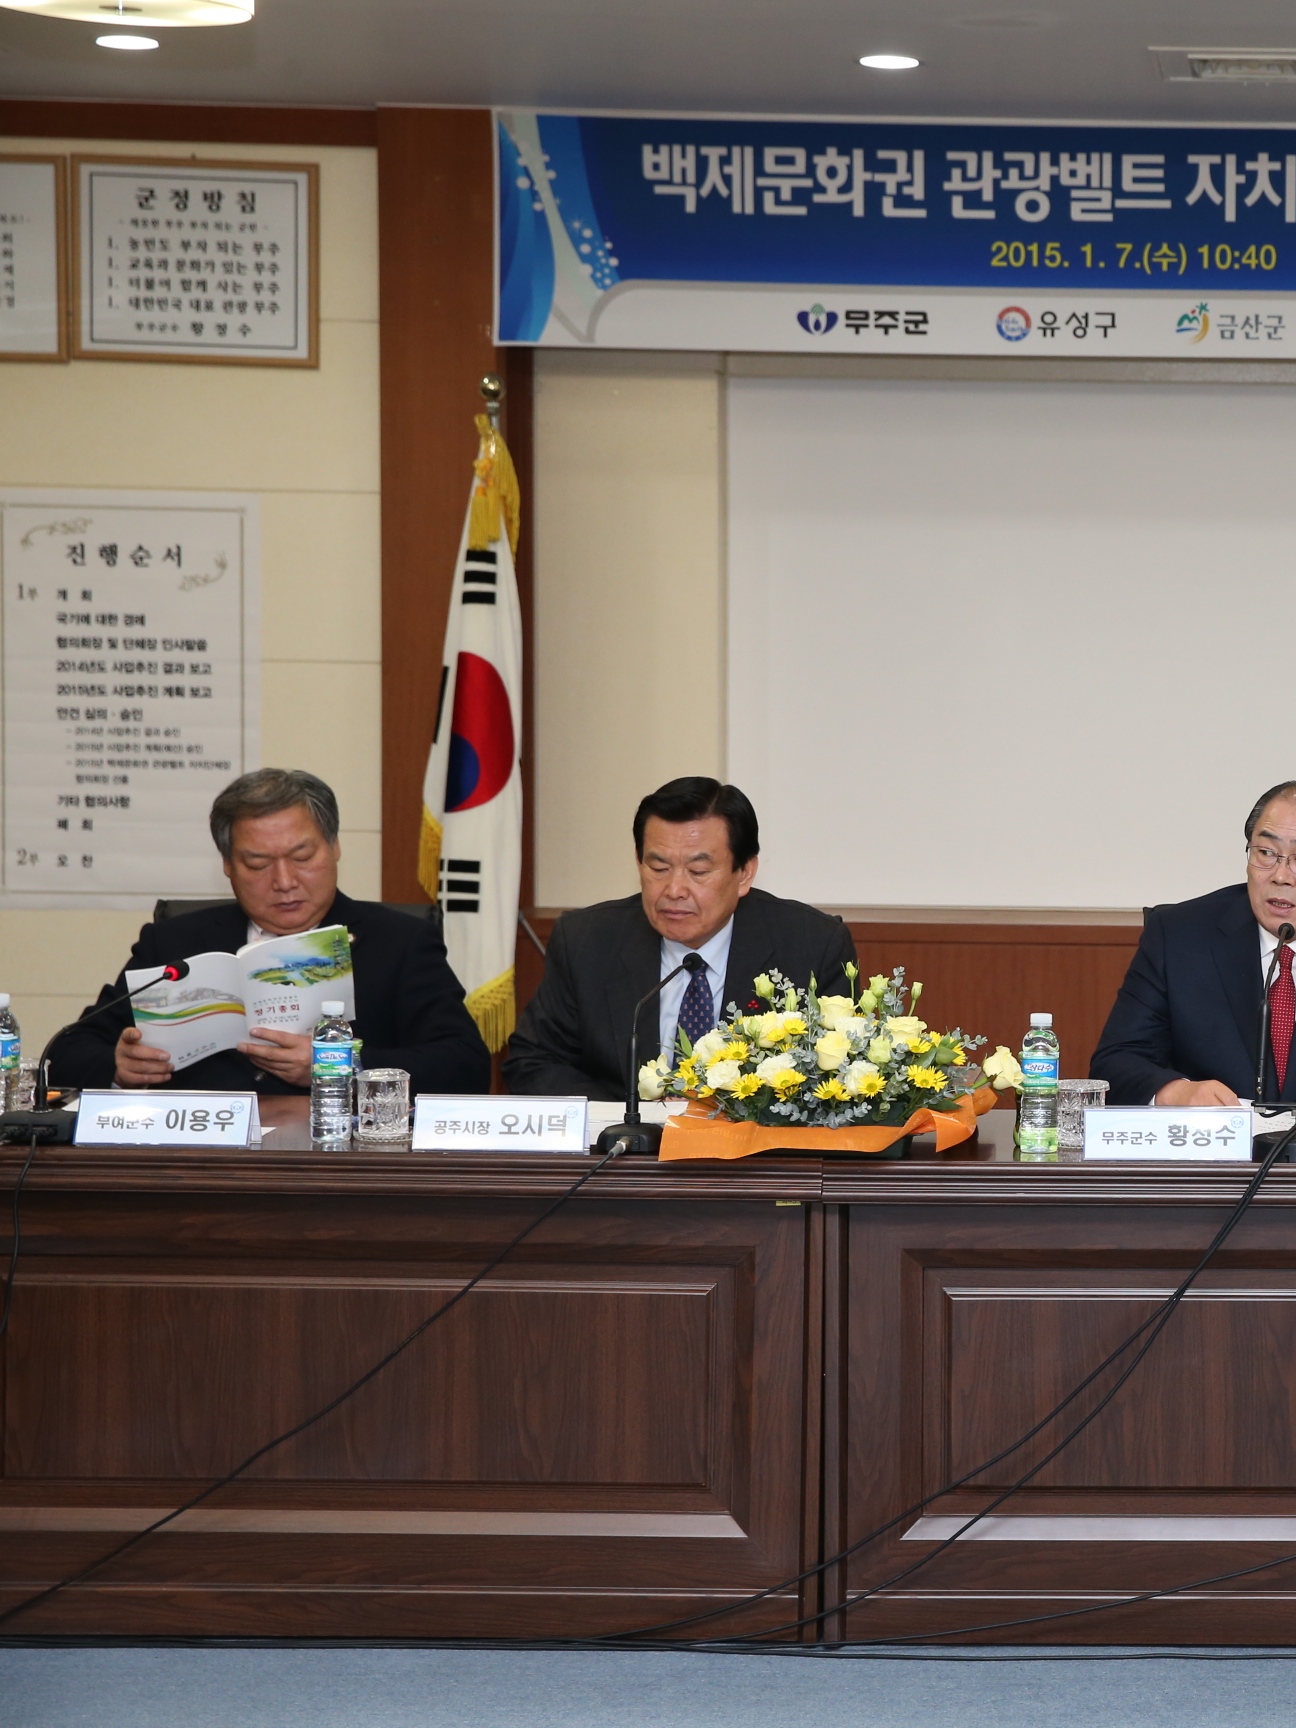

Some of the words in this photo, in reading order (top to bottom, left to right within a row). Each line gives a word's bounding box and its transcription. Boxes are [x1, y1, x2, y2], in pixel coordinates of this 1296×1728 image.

[641, 142, 927, 219] 백제문화권
[942, 149, 1173, 223] 관광벨트
[180, 238, 208, 254] 부자
[216, 240, 243, 255] 되는
[253, 241, 280, 256] 무주
[990, 240, 1071, 269] 2015.
[1081, 243, 1104, 269] 1.
[1115, 242, 1189, 275] 7.(수)
[1198, 244, 1278, 271] 10:40
[222, 260, 248, 275] 있는
[253, 261, 280, 277] 무주
[216, 280, 243, 295] 사는
[253, 281, 280, 296] 무주
[129, 296, 183, 312] 대한민국
[253, 301, 280, 315] 무주
[843, 310, 929, 336] 무주군
[1037, 311, 1117, 339] 유성구
[1216, 315, 1286, 341] 금산군
[56, 612, 91, 626] 국기에
[96, 613, 118, 627] 대한
[123, 614, 146, 627] 경례
[56, 636, 103, 650] 협의회장
[107, 637, 119, 650] 및
[123, 637, 158, 651] 단체장
[162, 639, 208, 651] 인사말씀
[56, 660, 108, 674] 2014년도
[112, 661, 158, 675] 사업추진
[163, 662, 186, 675] 결과
[189, 662, 213, 675] 보고
[56, 684, 108, 697] 2015년도
[112, 684, 158, 698] 사업추진
[163, 685, 186, 698] 계획
[189, 686, 213, 698] 보고
[56, 708, 80, 721] 안건
[85, 708, 107, 721] 심의
[120, 708, 144, 721] 승인
[57, 795, 80, 807] 기타
[84, 795, 130, 808] 협의사항
[96, 1114, 155, 1130] 부여군수
[164, 1108, 236, 1132] 이용우
[434, 1119, 491, 1136] 공주시장
[498, 1113, 568, 1137] 오시덕
[1101, 1131, 1158, 1146] 무주군수
